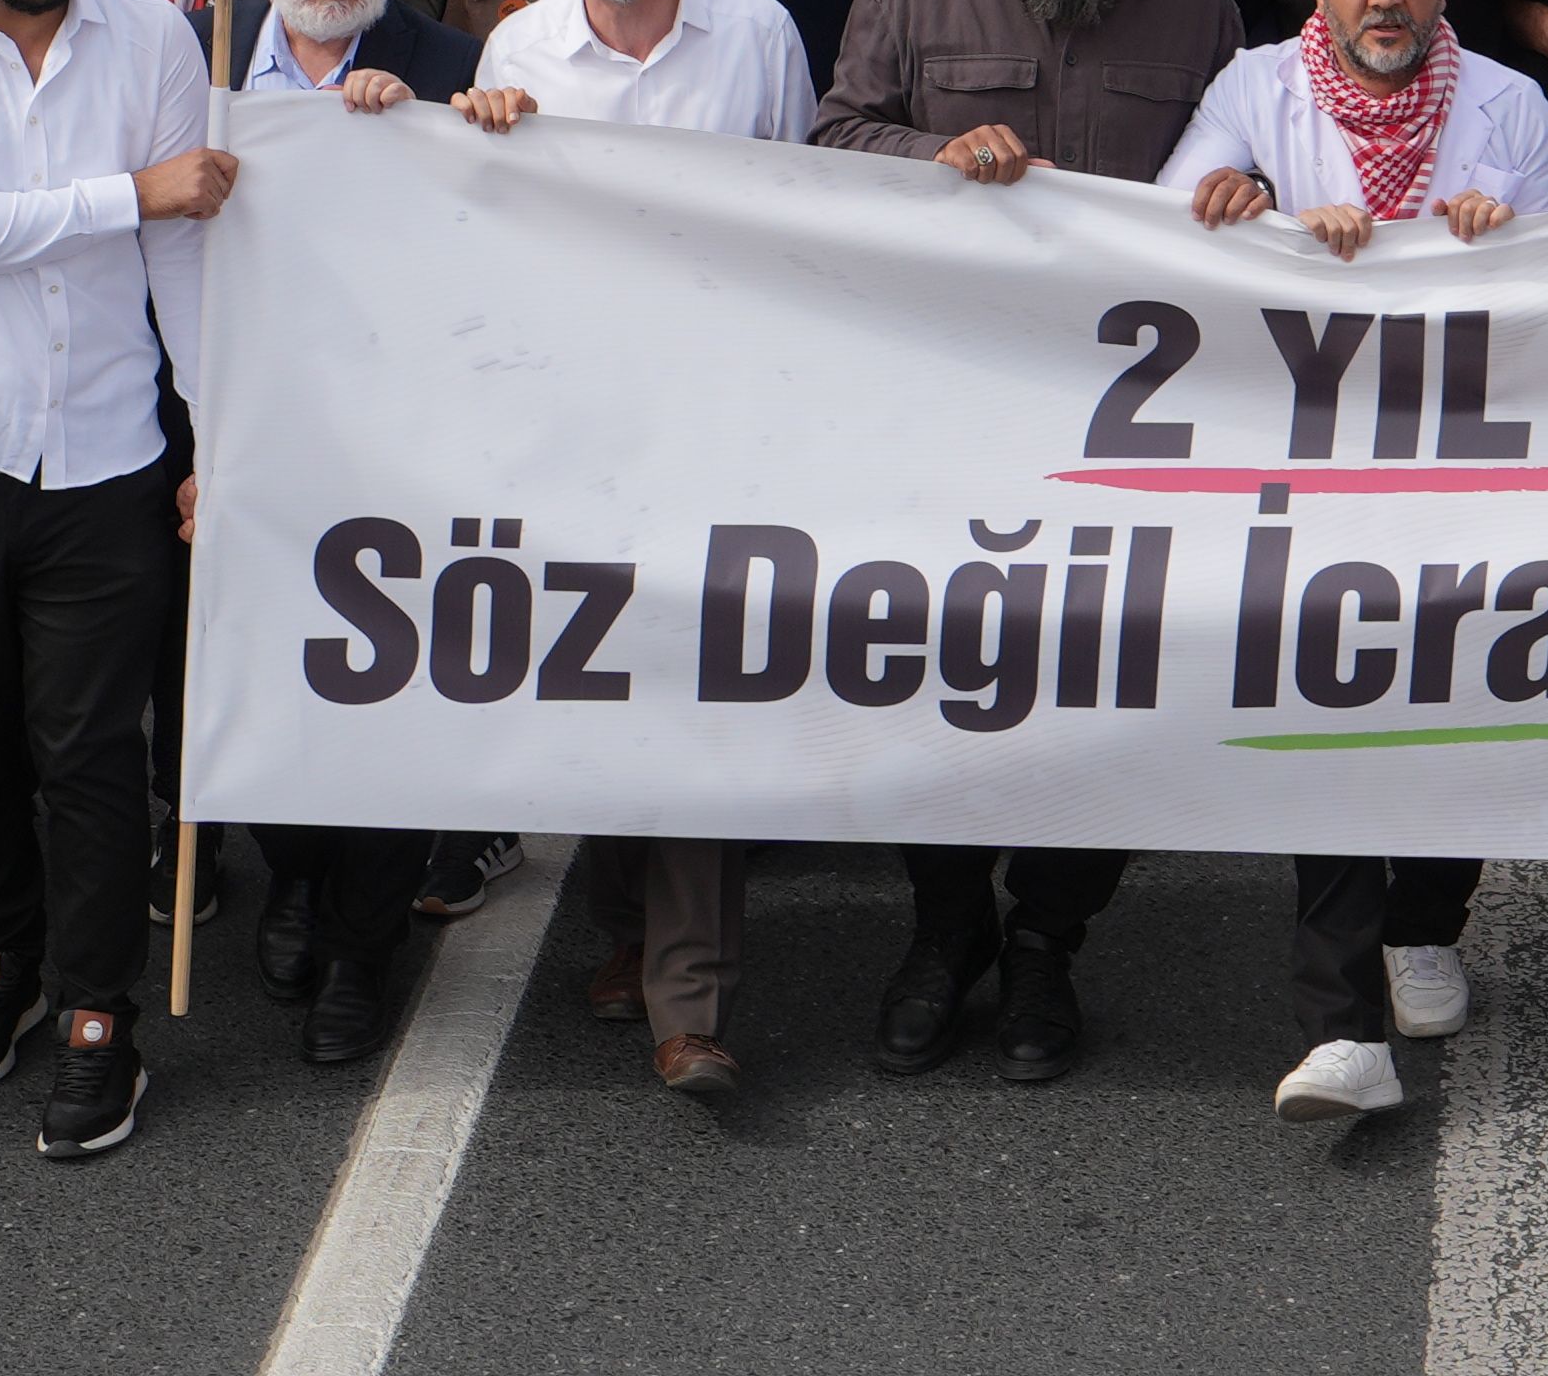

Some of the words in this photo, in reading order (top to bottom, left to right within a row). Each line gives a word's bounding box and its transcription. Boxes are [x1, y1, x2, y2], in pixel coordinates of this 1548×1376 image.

[1084, 301, 1200, 459] 2
[1260, 308, 1532, 460] YIL
[304, 517, 636, 706] Söz
[698, 520, 1173, 733] Değil
